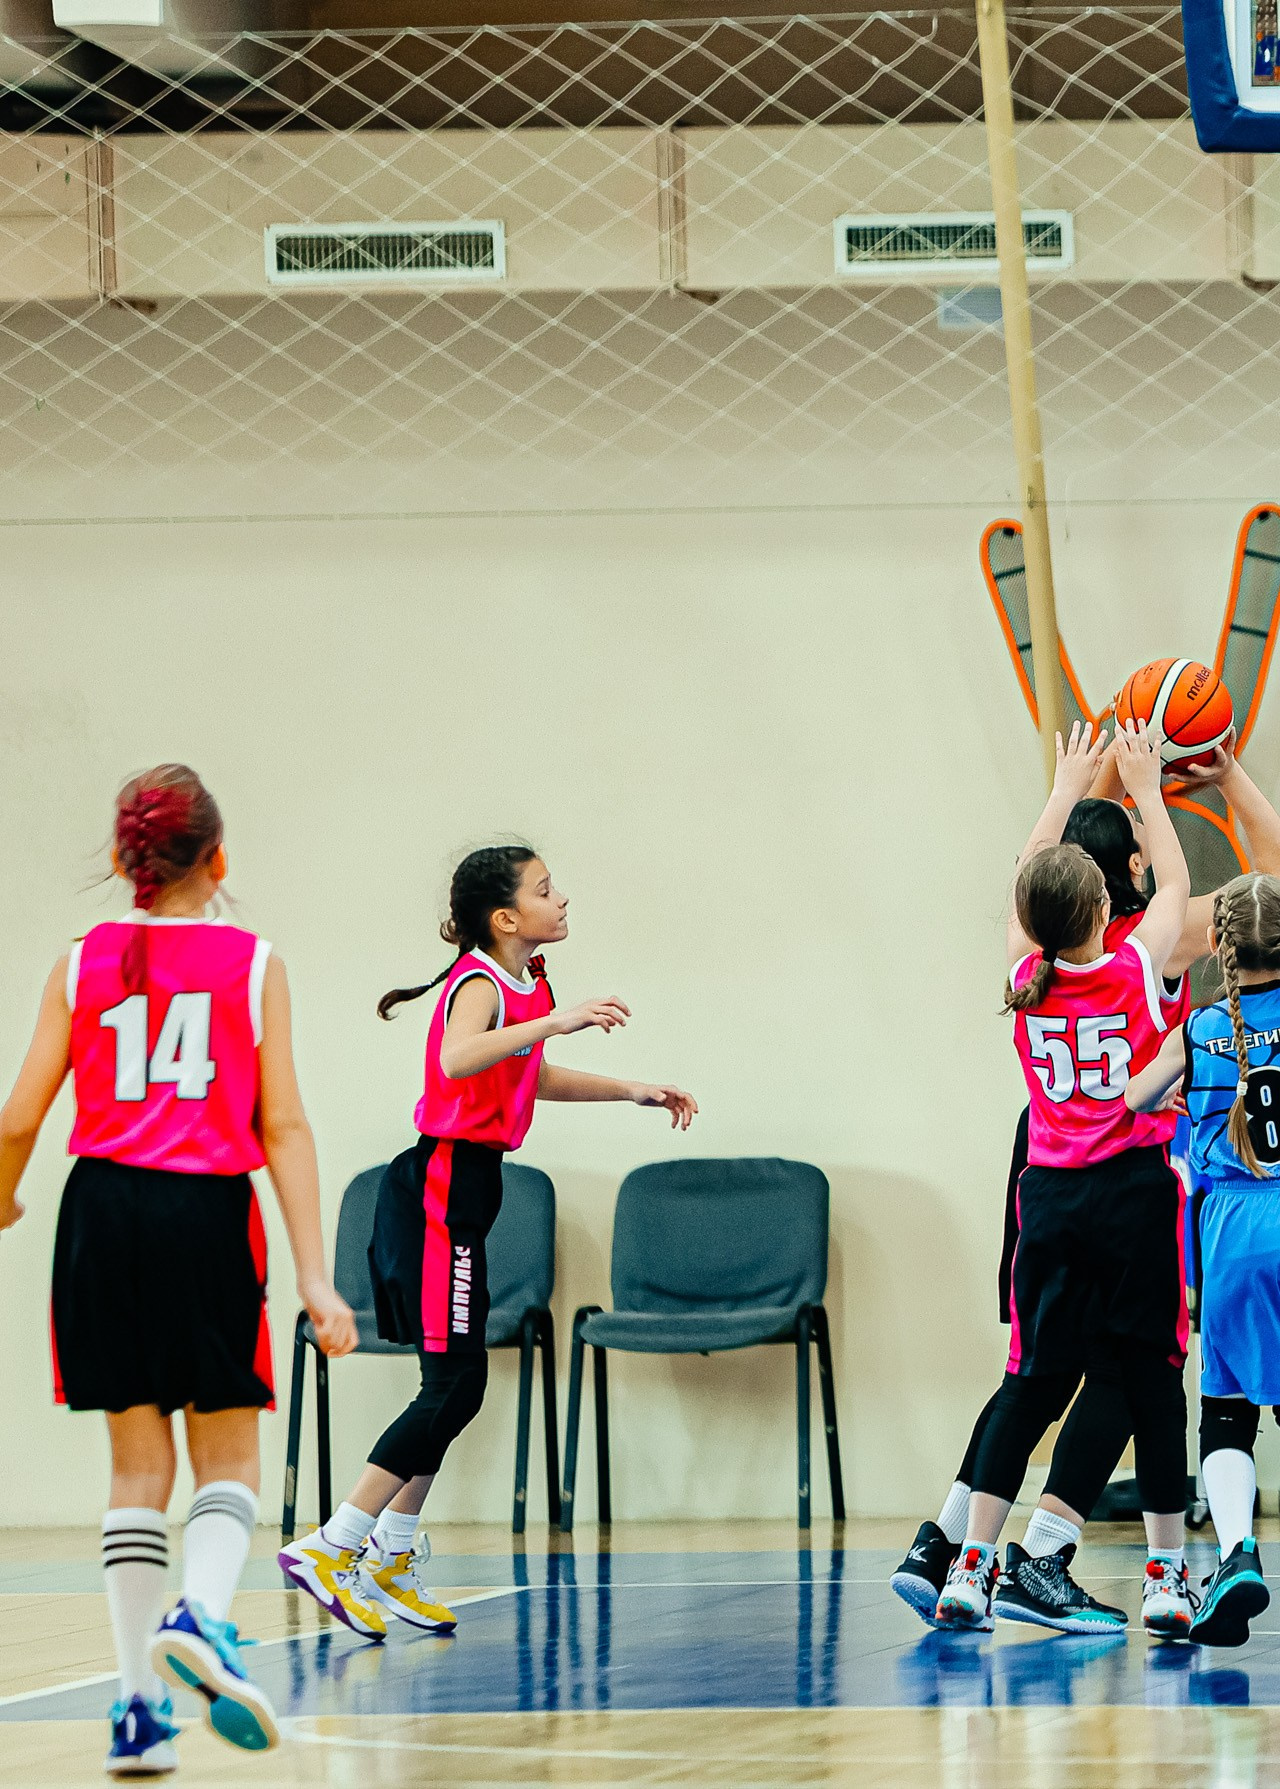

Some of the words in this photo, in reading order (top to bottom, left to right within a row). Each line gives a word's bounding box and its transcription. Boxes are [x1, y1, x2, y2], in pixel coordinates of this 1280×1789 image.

[99, 991, 217, 1102] 14
[1025, 1013, 1133, 1104] 55
[452, 1245, 472, 1334] ИМПУЛЬС
